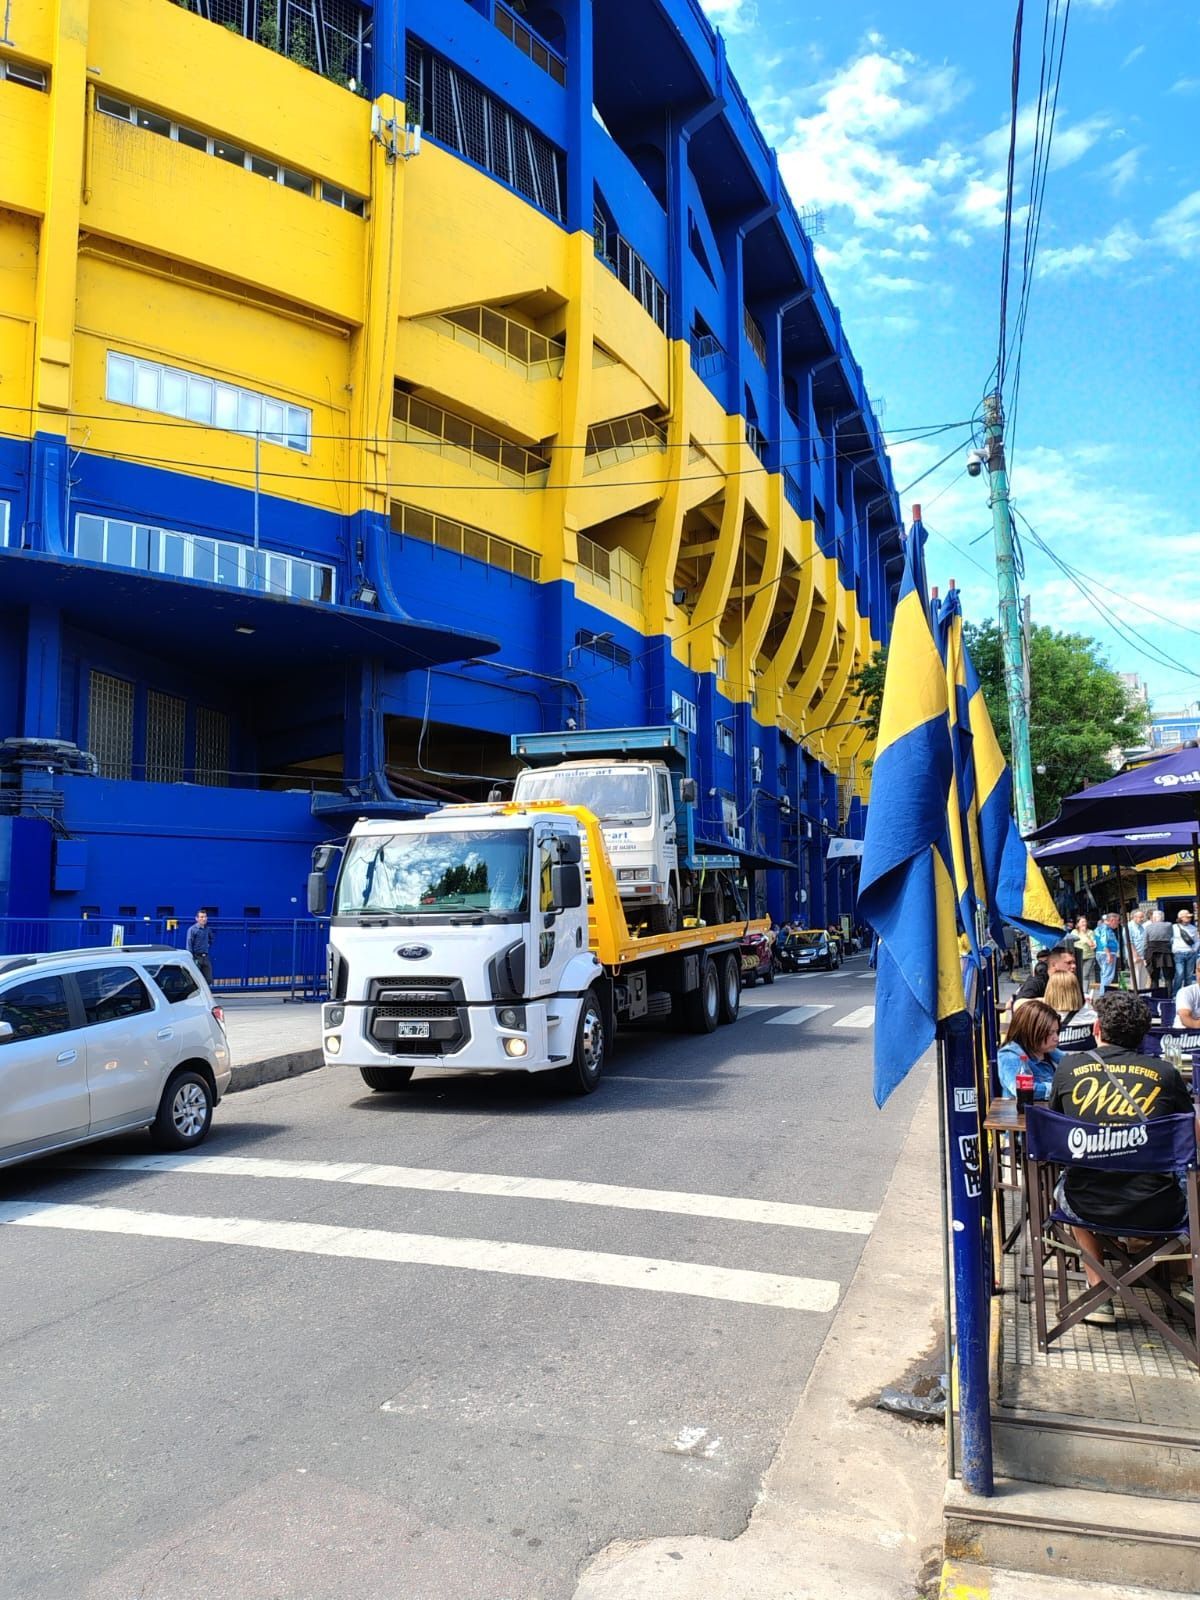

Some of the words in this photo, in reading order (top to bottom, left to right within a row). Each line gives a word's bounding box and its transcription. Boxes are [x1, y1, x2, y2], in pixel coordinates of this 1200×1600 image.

[1058, 1026, 1091, 1042] uilmes
[1073, 1063, 1103, 1077] RUSTIC
[1128, 1065, 1159, 1082] REFUEL
[1071, 1076, 1162, 1117] Wild
[1067, 1125, 1149, 1159] Quilmes
